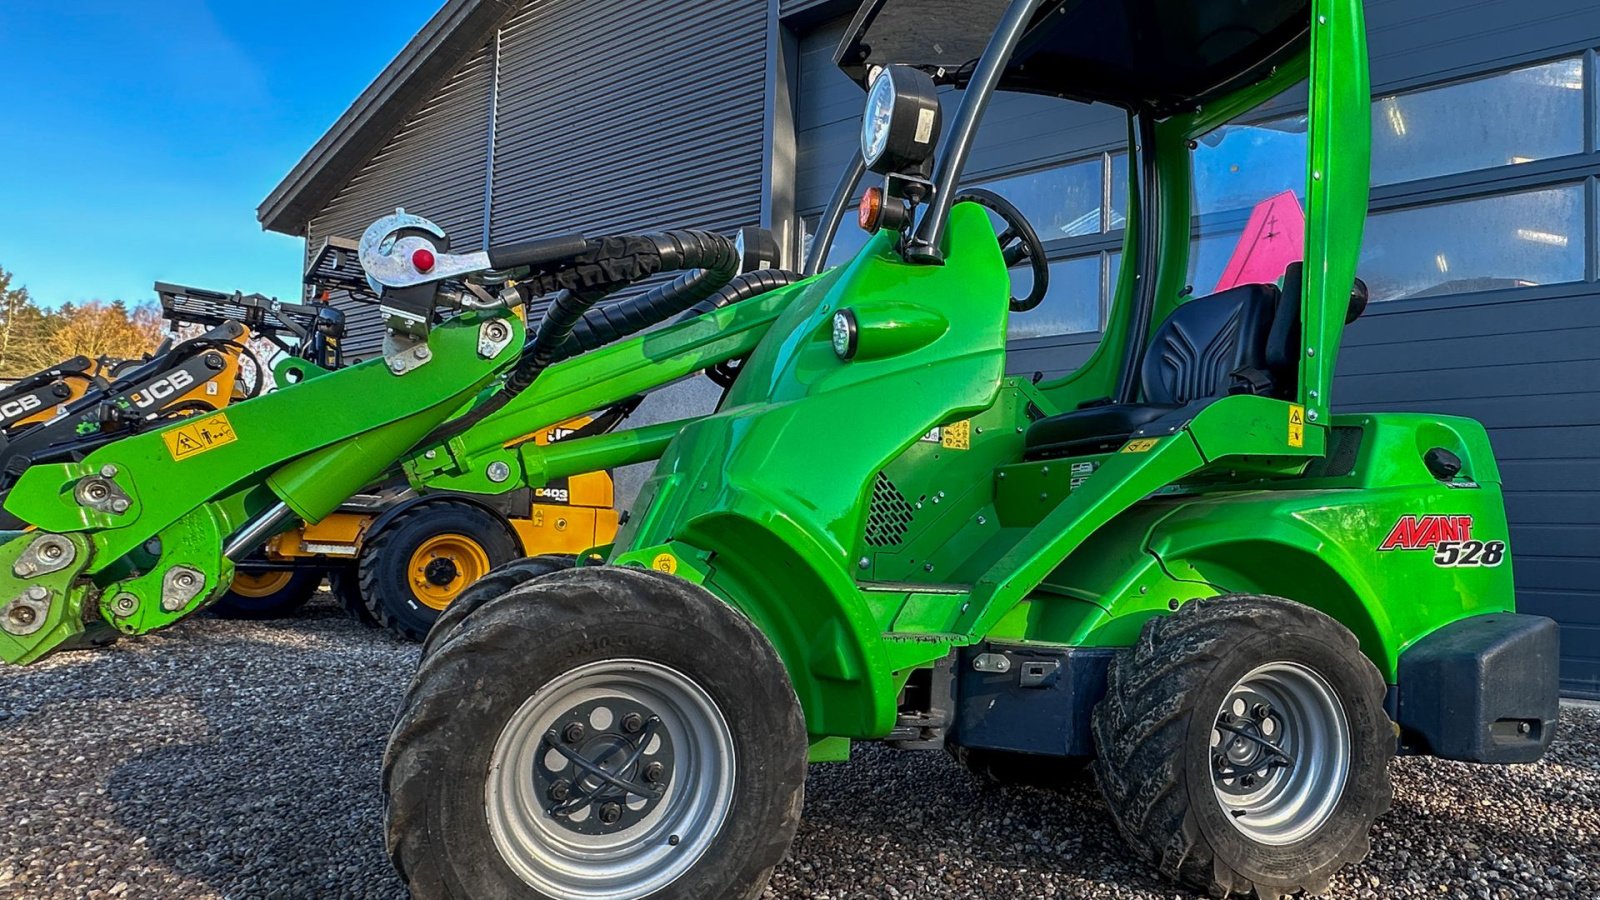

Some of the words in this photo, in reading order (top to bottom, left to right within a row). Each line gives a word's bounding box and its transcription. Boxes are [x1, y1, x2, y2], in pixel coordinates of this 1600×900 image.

[135, 369, 194, 408] JCB
[0, 394, 42, 422] CB
[1378, 514, 1473, 551] AVANT
[1433, 540, 1505, 567] 528
